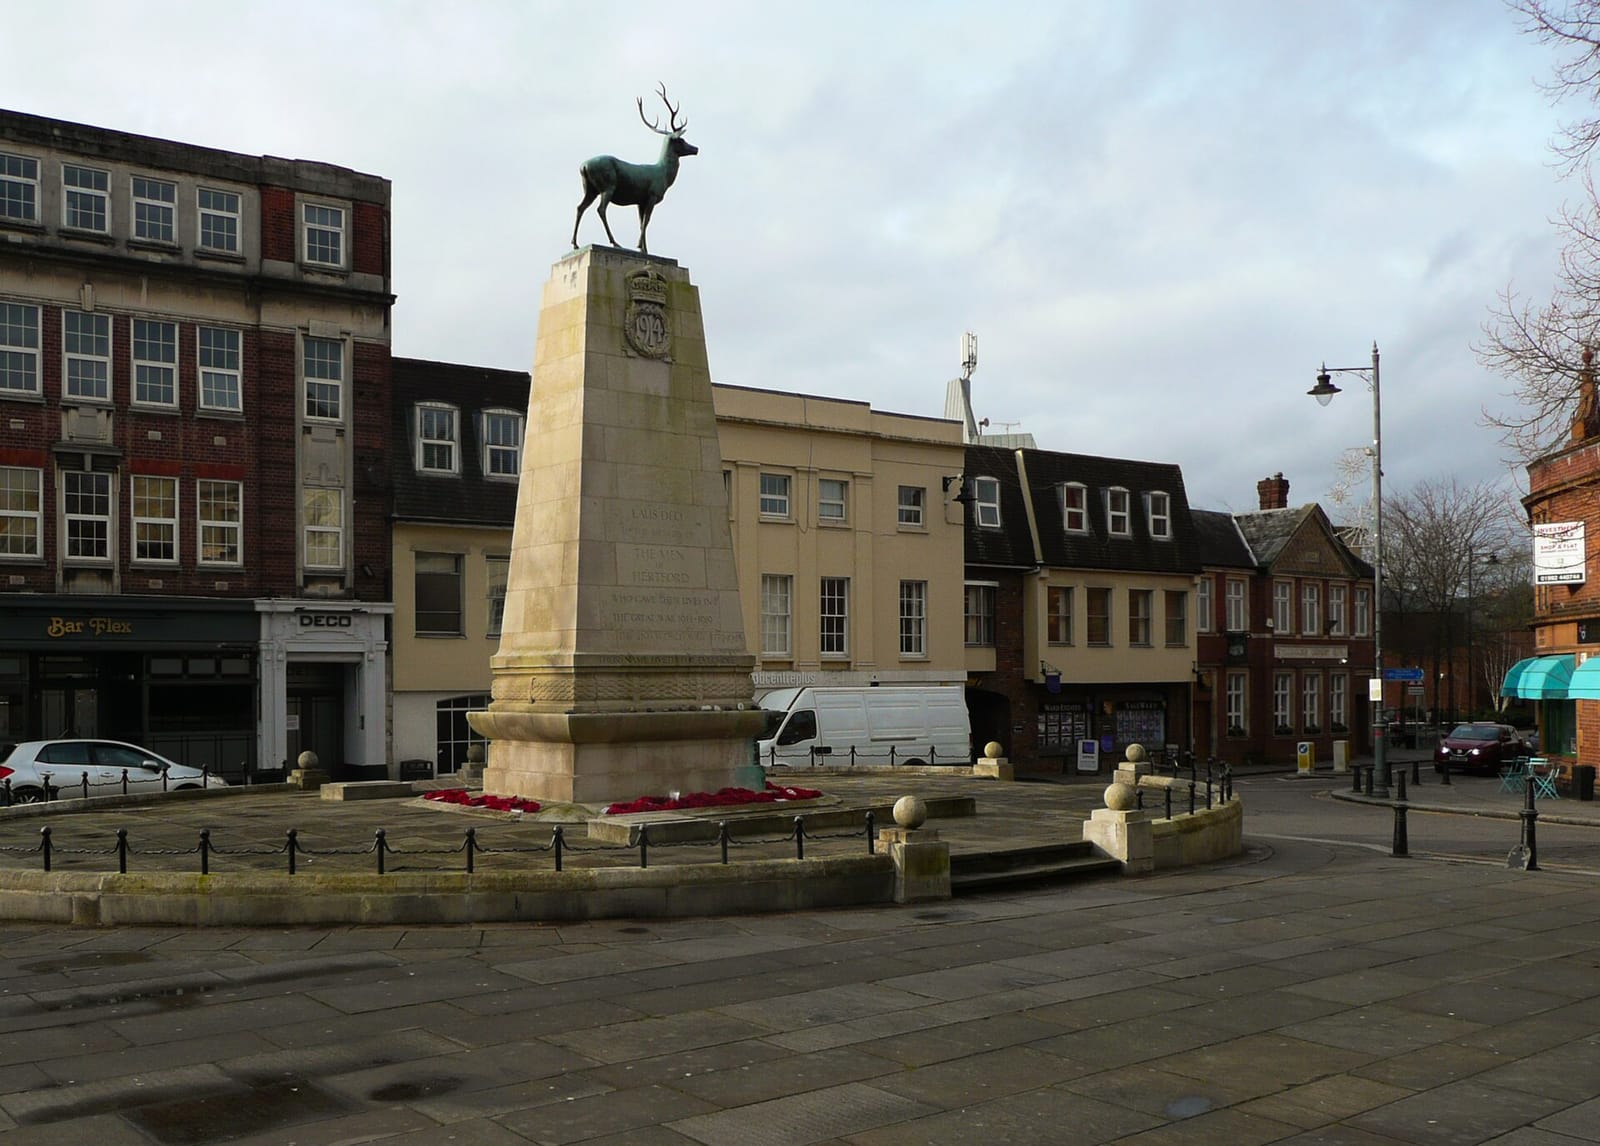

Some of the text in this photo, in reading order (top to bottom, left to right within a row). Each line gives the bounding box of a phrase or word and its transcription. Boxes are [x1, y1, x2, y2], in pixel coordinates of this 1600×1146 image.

[635, 315, 663, 346] 1914
[47, 617, 132, 637] Bar Flex
[299, 615, 352, 627] DECO
[752, 671, 816, 686] obcentreplus
